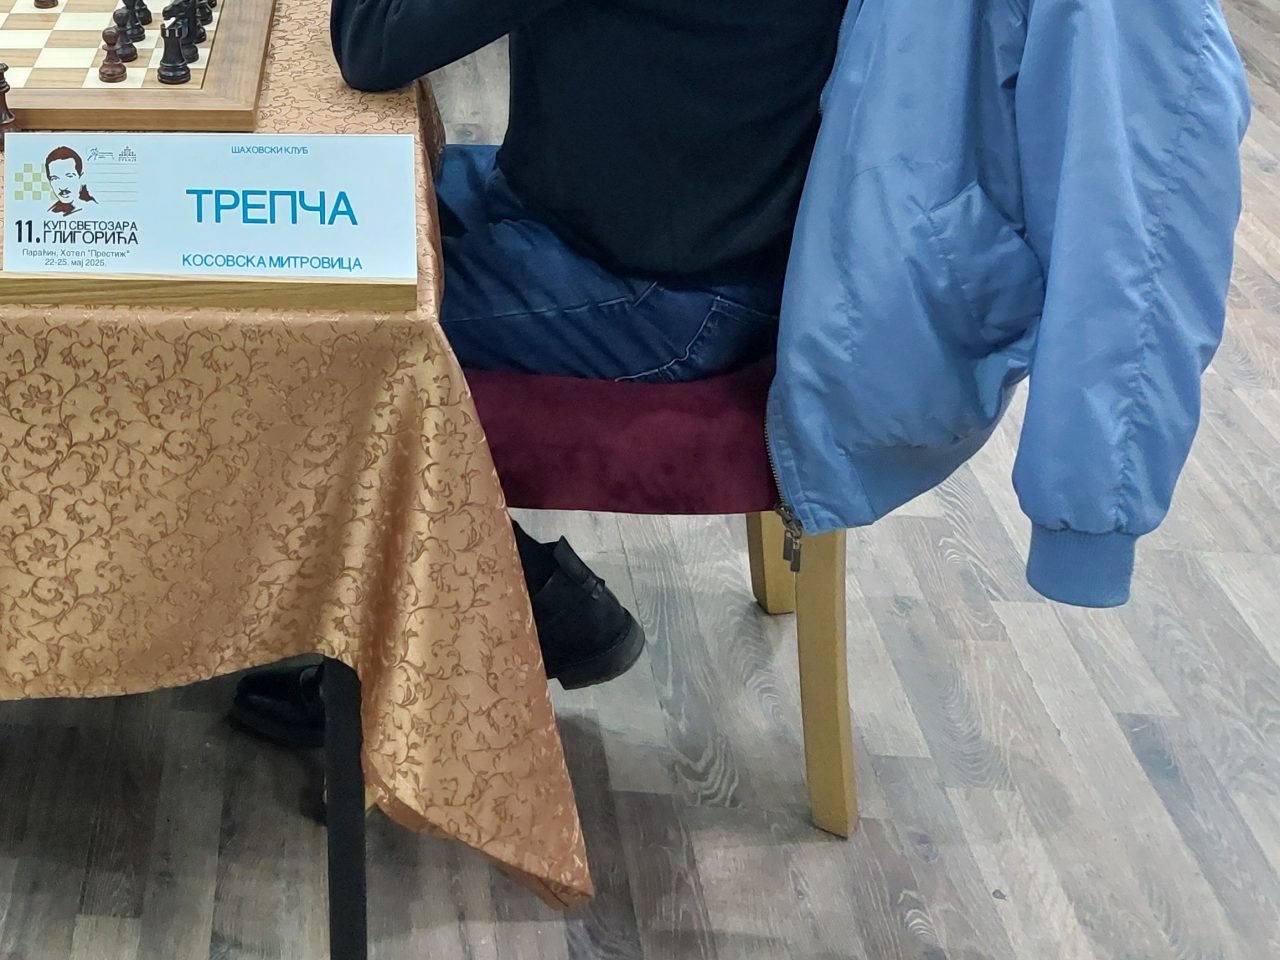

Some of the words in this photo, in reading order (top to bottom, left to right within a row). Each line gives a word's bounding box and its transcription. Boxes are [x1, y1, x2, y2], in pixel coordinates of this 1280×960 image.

[231, 146, 283, 154] ШАХОВСКИ
[284, 146, 309, 154] КЛУБ
[186, 189, 358, 225] ТРЕПЧА
[15, 220, 40, 243] 11.
[44, 220, 66, 230] КУП
[69, 220, 138, 231] СВЕТОЗАРА
[44, 230, 138, 244] ГЛИГОРИЋА
[182, 254, 266, 268] КОСОВСКА
[269, 256, 362, 272] МИТРОВИЦА
